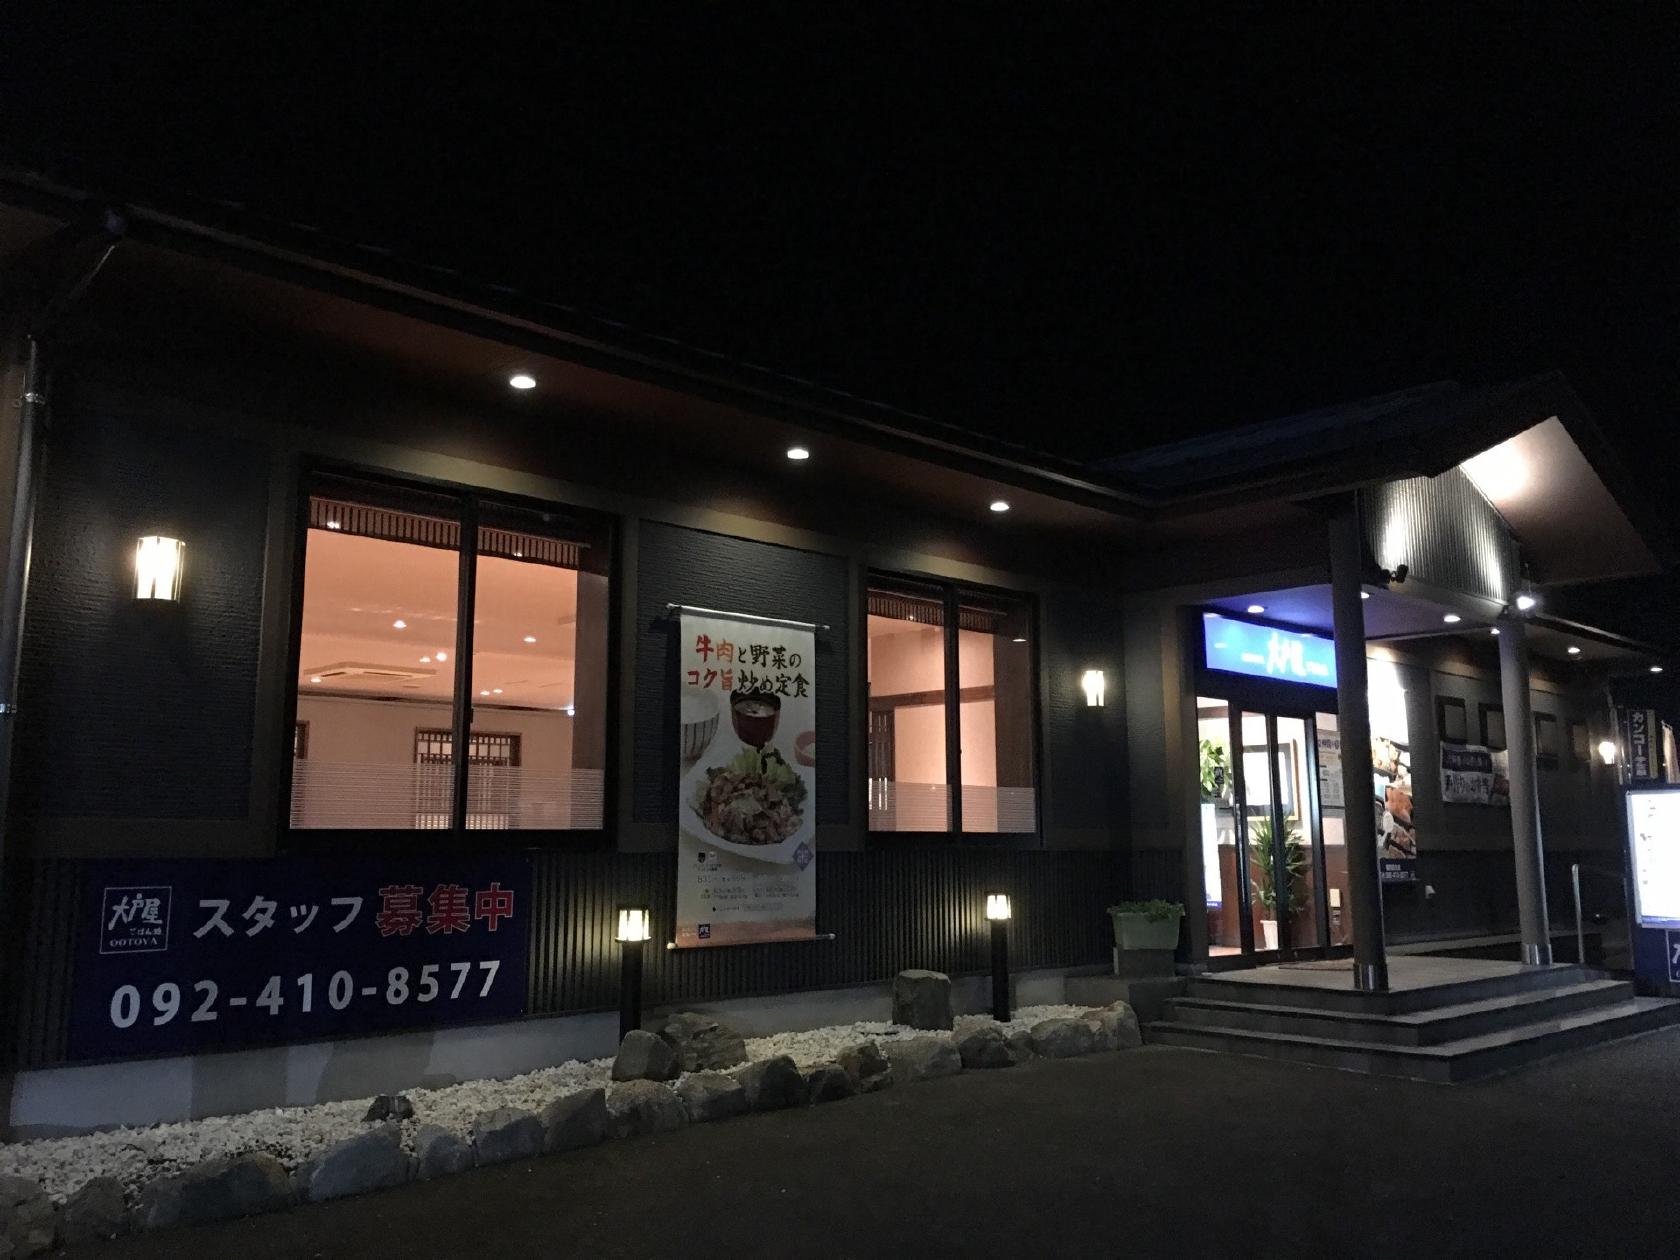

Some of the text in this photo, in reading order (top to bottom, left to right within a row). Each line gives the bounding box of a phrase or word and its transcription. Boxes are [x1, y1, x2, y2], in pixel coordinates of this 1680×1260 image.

[695, 634, 802, 669] 牛肉と野菜の
[687, 668, 810, 699] コク旨炒め定食
[107, 892, 164, 931] 大戸屋
[193, 881, 515, 939] スタッフ募集中
[109, 936, 159, 948] OOTOYA
[109, 959, 501, 1029] 092-410-8577
